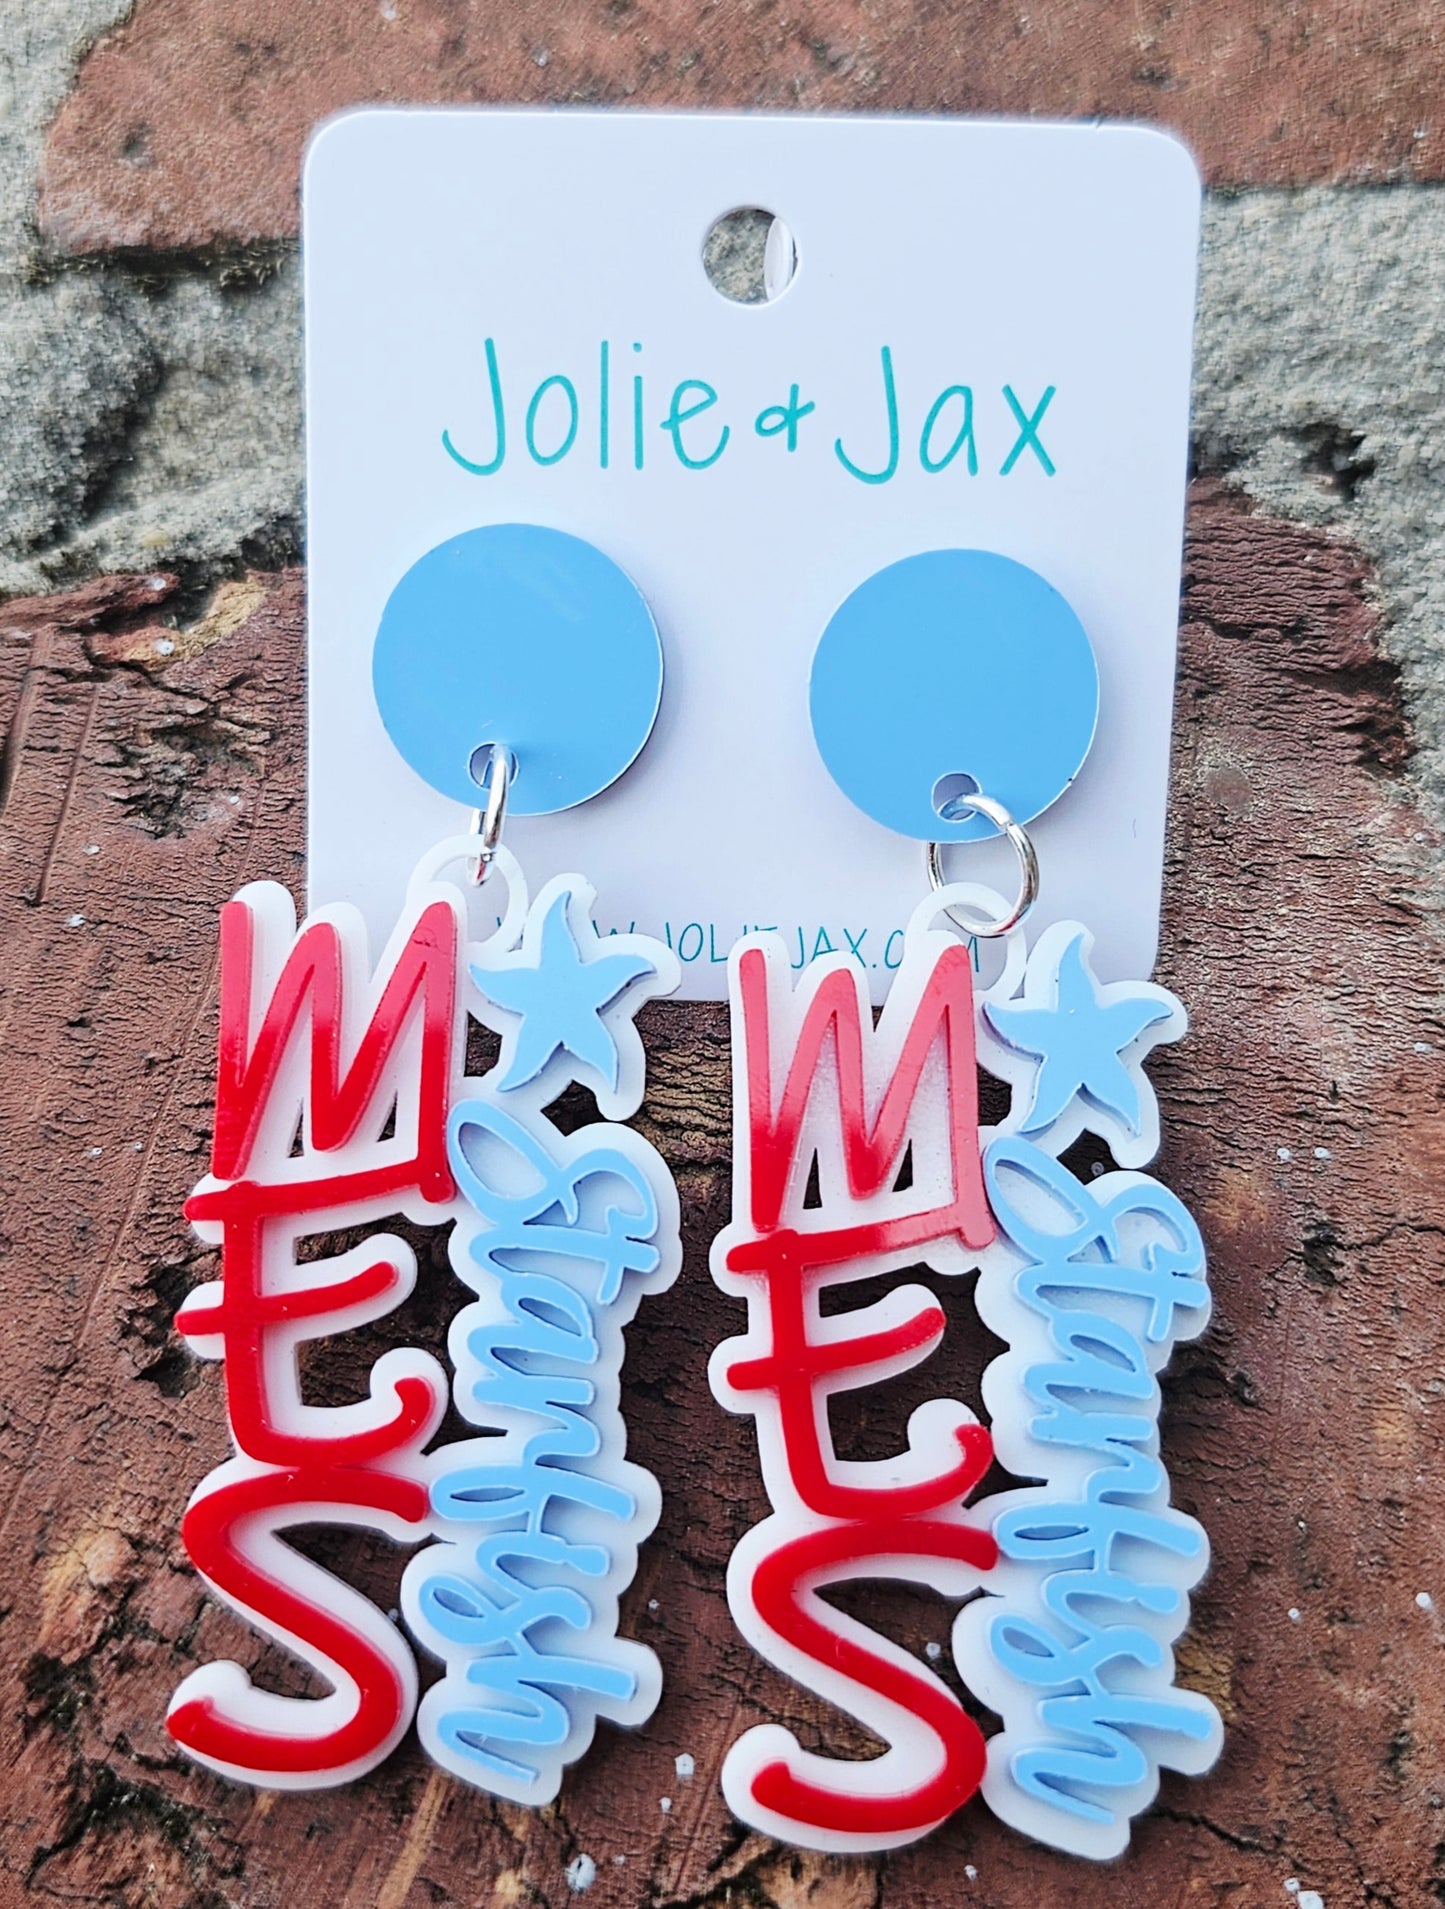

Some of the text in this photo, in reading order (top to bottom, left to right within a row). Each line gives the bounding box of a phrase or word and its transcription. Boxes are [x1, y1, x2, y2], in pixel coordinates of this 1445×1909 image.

[441, 337, 731, 477] Jolie
[834, 345, 1057, 485] Jax
[163, 899, 457, 1775] MES
[416, 1098, 663, 1784] Starfish
[726, 944, 1000, 1836] MES
[984, 1139, 1216, 1827] Starfish
